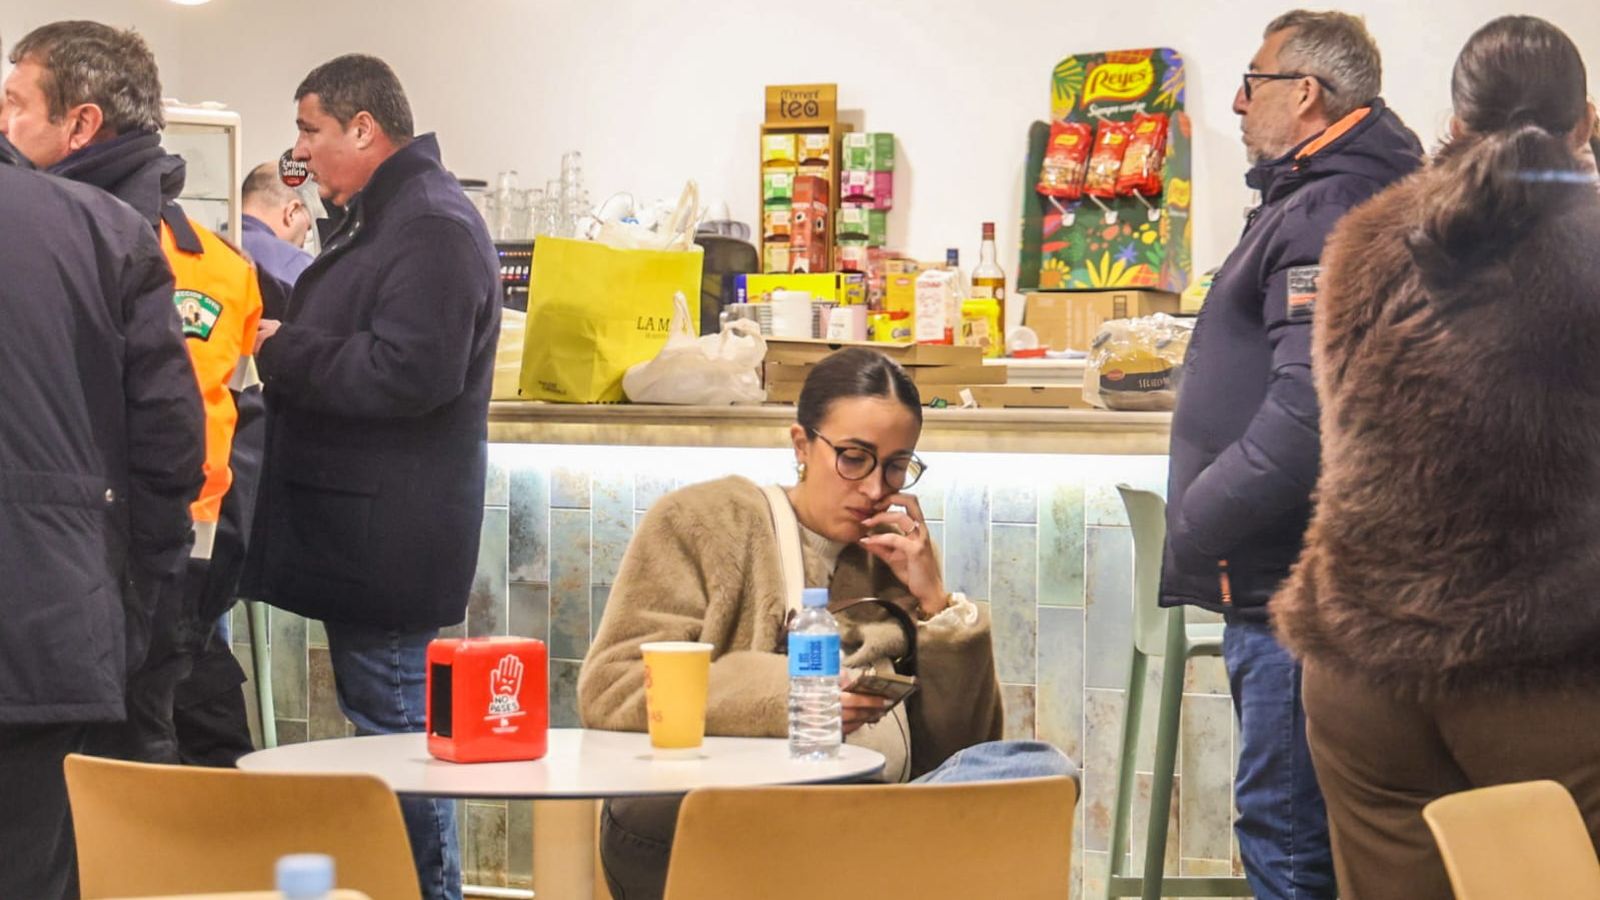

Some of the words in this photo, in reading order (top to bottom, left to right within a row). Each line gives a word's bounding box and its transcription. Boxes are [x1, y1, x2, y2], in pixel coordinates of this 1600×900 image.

[1090, 69, 1147, 94] Reyes
[780, 97, 820, 119] tea
[637, 316, 655, 331] LA
[490, 702, 518, 712] PASES
[494, 696, 509, 704] NO
